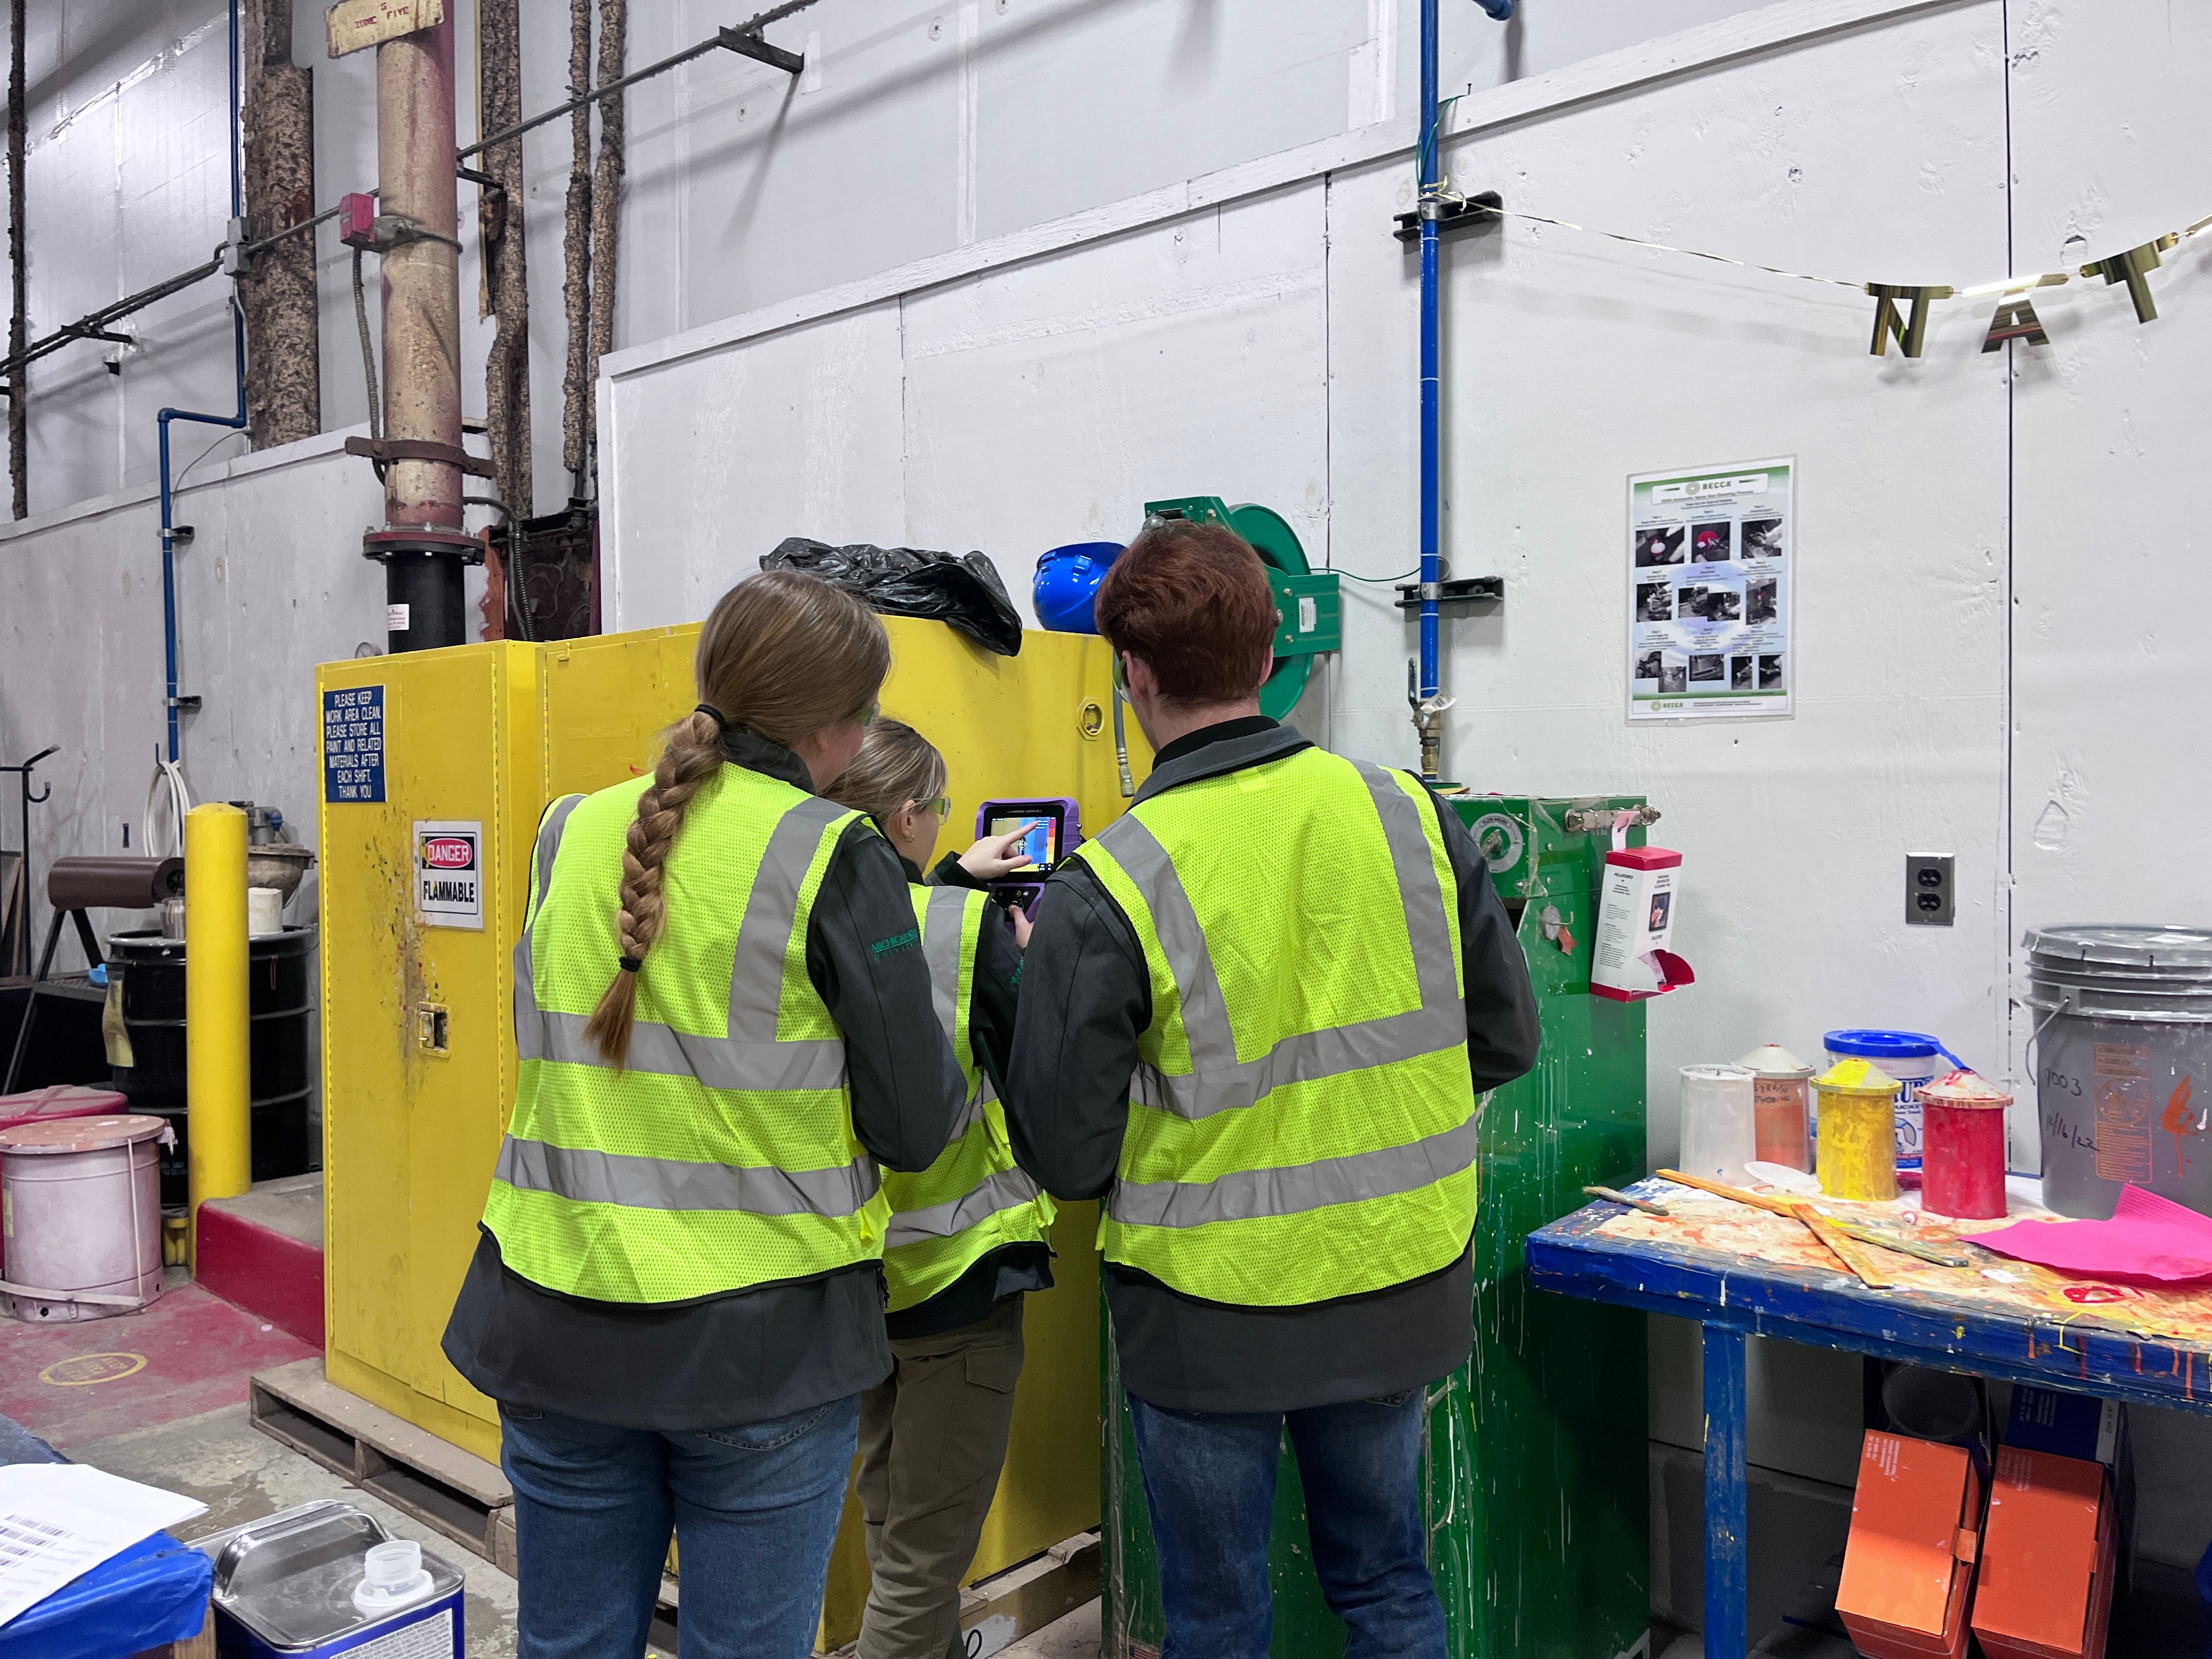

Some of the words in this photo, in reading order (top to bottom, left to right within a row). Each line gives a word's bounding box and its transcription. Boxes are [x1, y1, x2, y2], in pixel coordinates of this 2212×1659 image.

[387, 6, 409, 20] FIVE
[1702, 481, 1731, 489] BECCA
[335, 692, 356, 707] PLEASE
[358, 691, 372, 705] KEEP
[325, 709, 342, 723] WORK
[345, 708, 359, 721] AREA
[326, 724, 347, 738] PLEASE
[349, 723, 368, 737] STORE
[370, 721, 381, 735] ALL
[326, 740, 341, 753] PAINT
[344, 739, 355, 752] AND
[357, 737, 381, 752] RELATED
[329, 754, 359, 768] MATERIALS
[360, 753, 379, 766] AFTER
[337, 770, 352, 783] EACH
[338, 785, 358, 798] THANK
[360, 785, 371, 798] YOU
[427, 844, 469, 861] DANGER
[424, 881, 474, 902] FLAMMABLE
